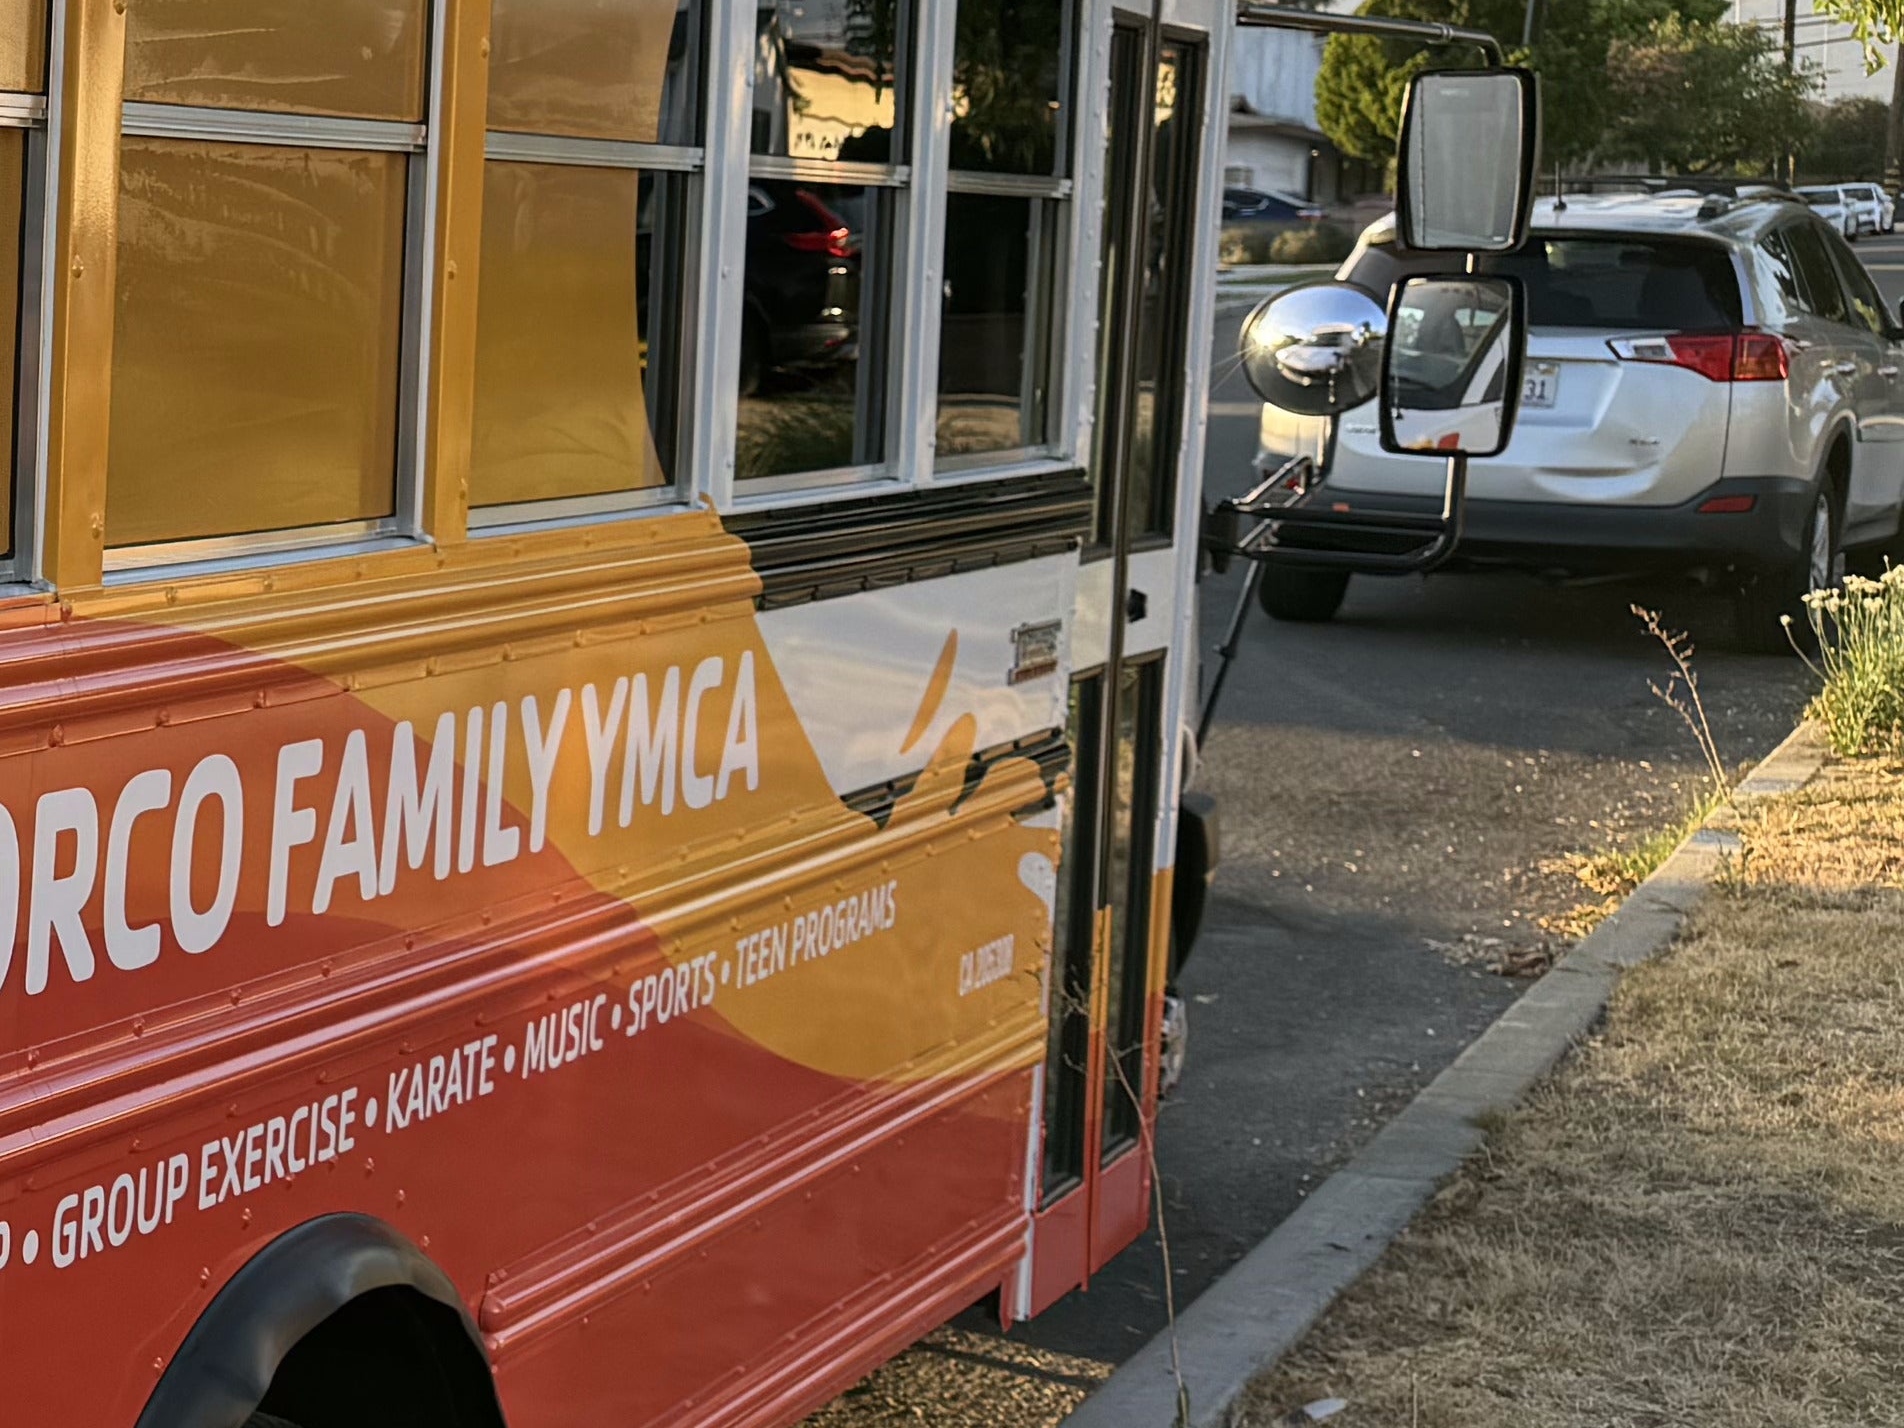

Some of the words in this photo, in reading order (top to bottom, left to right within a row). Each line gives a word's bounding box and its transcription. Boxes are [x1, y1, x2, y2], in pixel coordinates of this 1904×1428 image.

[266, 685, 571, 928] FAMILY
[579, 649, 759, 836] YMCA
[51, 1152, 189, 1270] GROUP
[197, 1086, 359, 1211] EXERCISE
[385, 1034, 497, 1134] KARATE
[521, 994, 608, 1079] MUSIC
[625, 950, 716, 1038] SPORTS
[734, 927, 786, 990] TEEN
[790, 880, 898, 966] PROGRAMS
